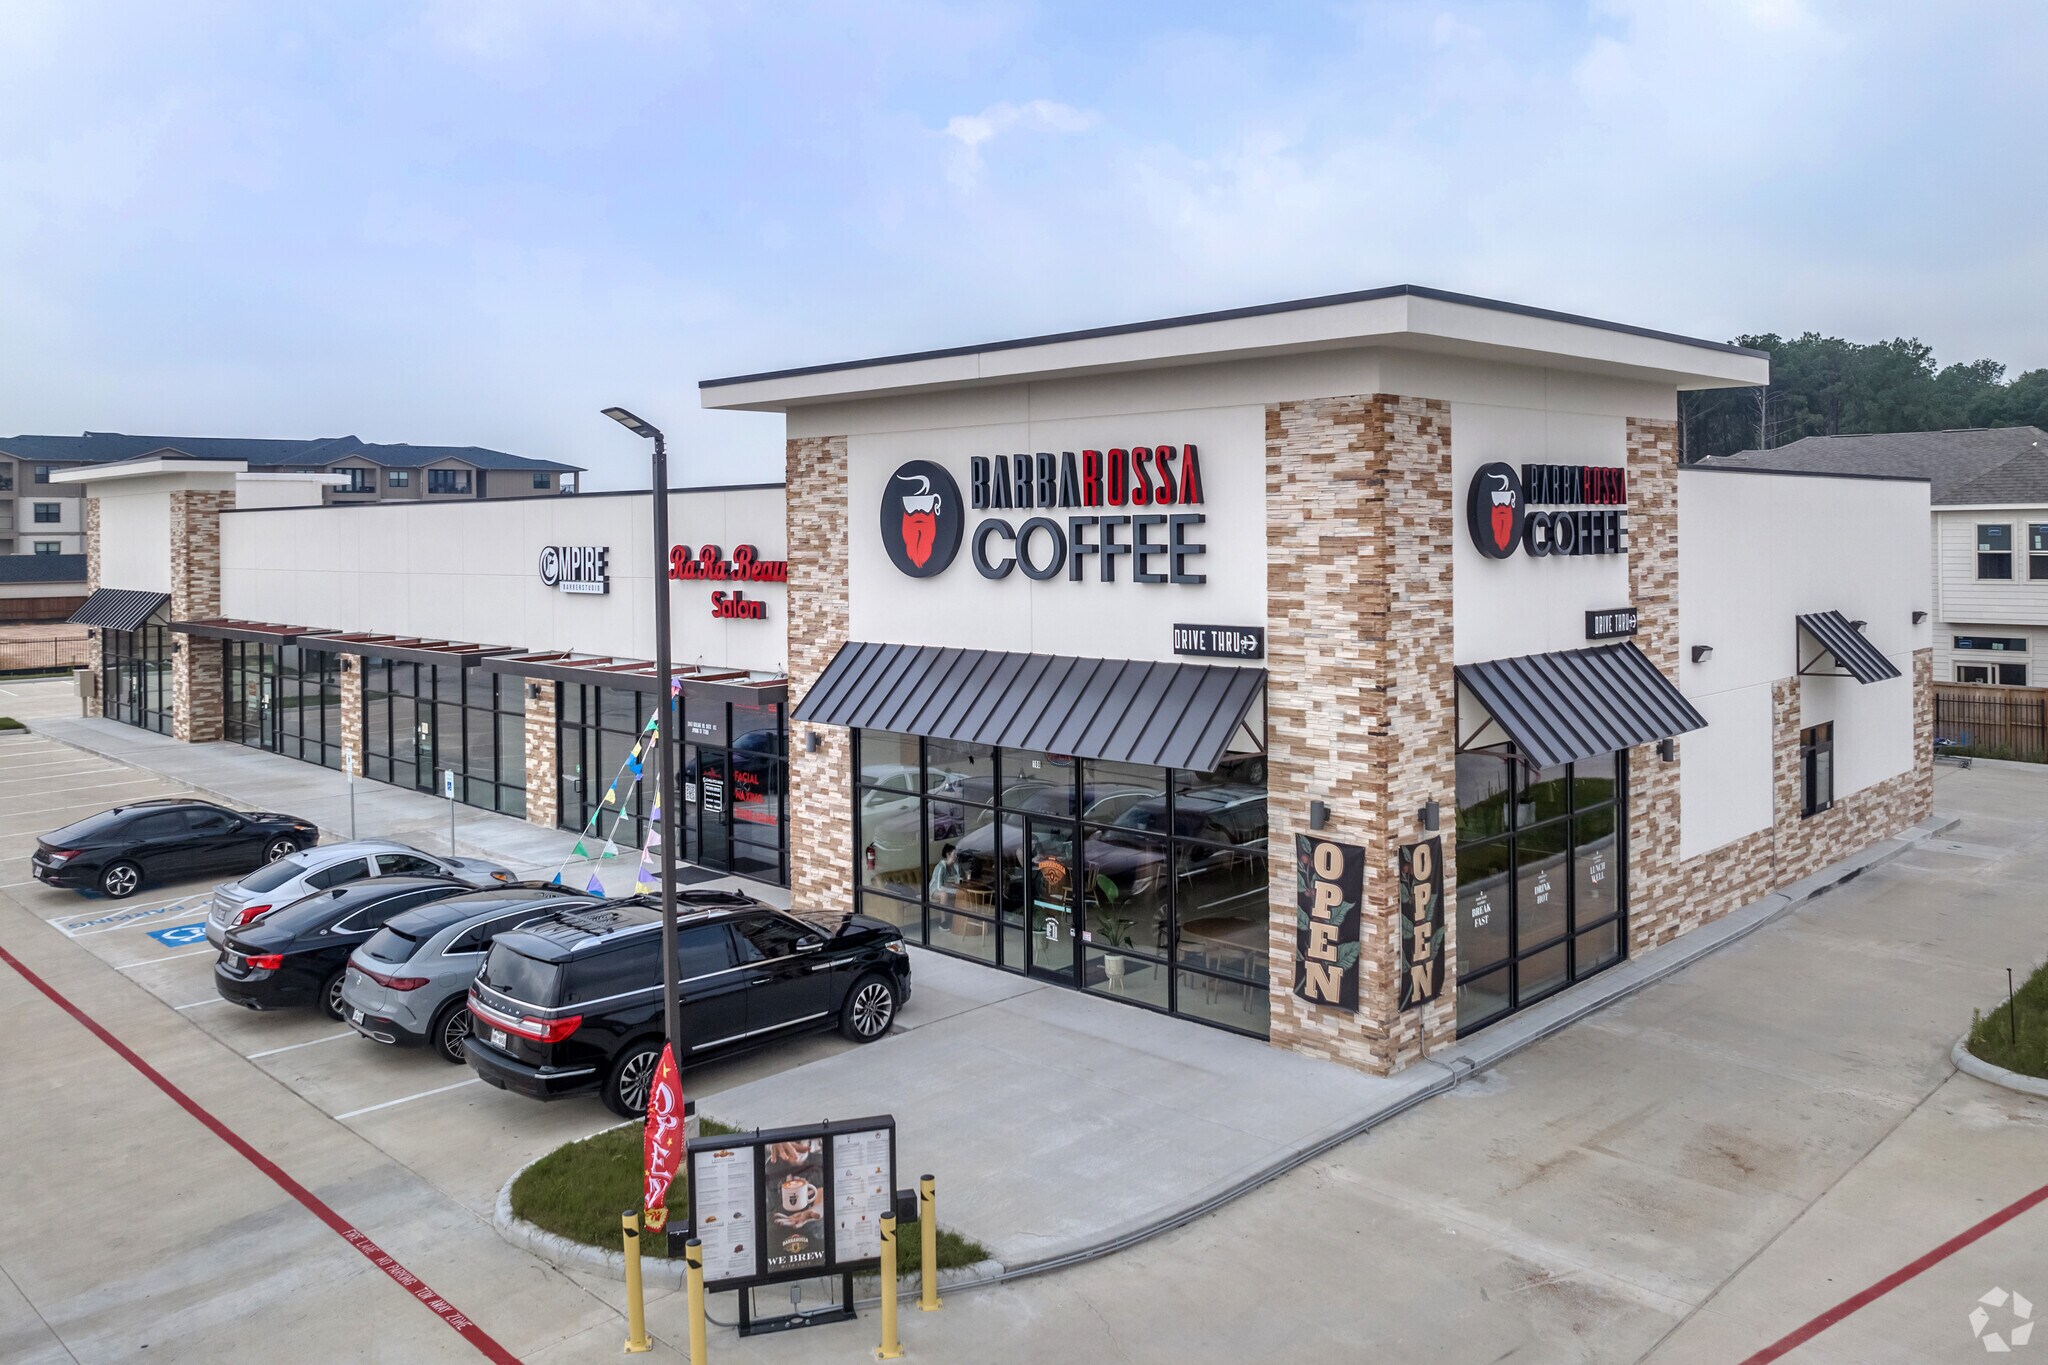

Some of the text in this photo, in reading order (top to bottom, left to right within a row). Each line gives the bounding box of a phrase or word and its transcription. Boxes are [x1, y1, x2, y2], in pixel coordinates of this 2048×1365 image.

[971, 444, 1204, 509] BARBAROSSA
[1525, 464, 1627, 505] BARBAROSSA
[1526, 510, 1628, 557] COFFEE
[971, 513, 1206, 584] COFFEE
[711, 590, 766, 619] Salon
[1595, 613, 1630, 635] DRIVE THRU
[1174, 629, 1240, 652] DRIVE THRU
[734, 771, 759, 785] FACIAL
[734, 790, 765, 804] WAXING
[1589, 862, 1606, 875] LUNCH
[1534, 882, 1552, 896] DRINK
[1536, 893, 1549, 905] HOT
[68, 905, 184, 929] PARKING
[1471, 902, 1491, 918] BREAK
[1474, 915, 1490, 928] FAST
[1305, 842, 1344, 1003] OPEN
[1410, 843, 1434, 1003] OPEN
[767, 1250, 825, 1266] WE BREW
[342, 1228, 473, 1331] FIRE LANE NO PARKING TOW AWAY ZONE
